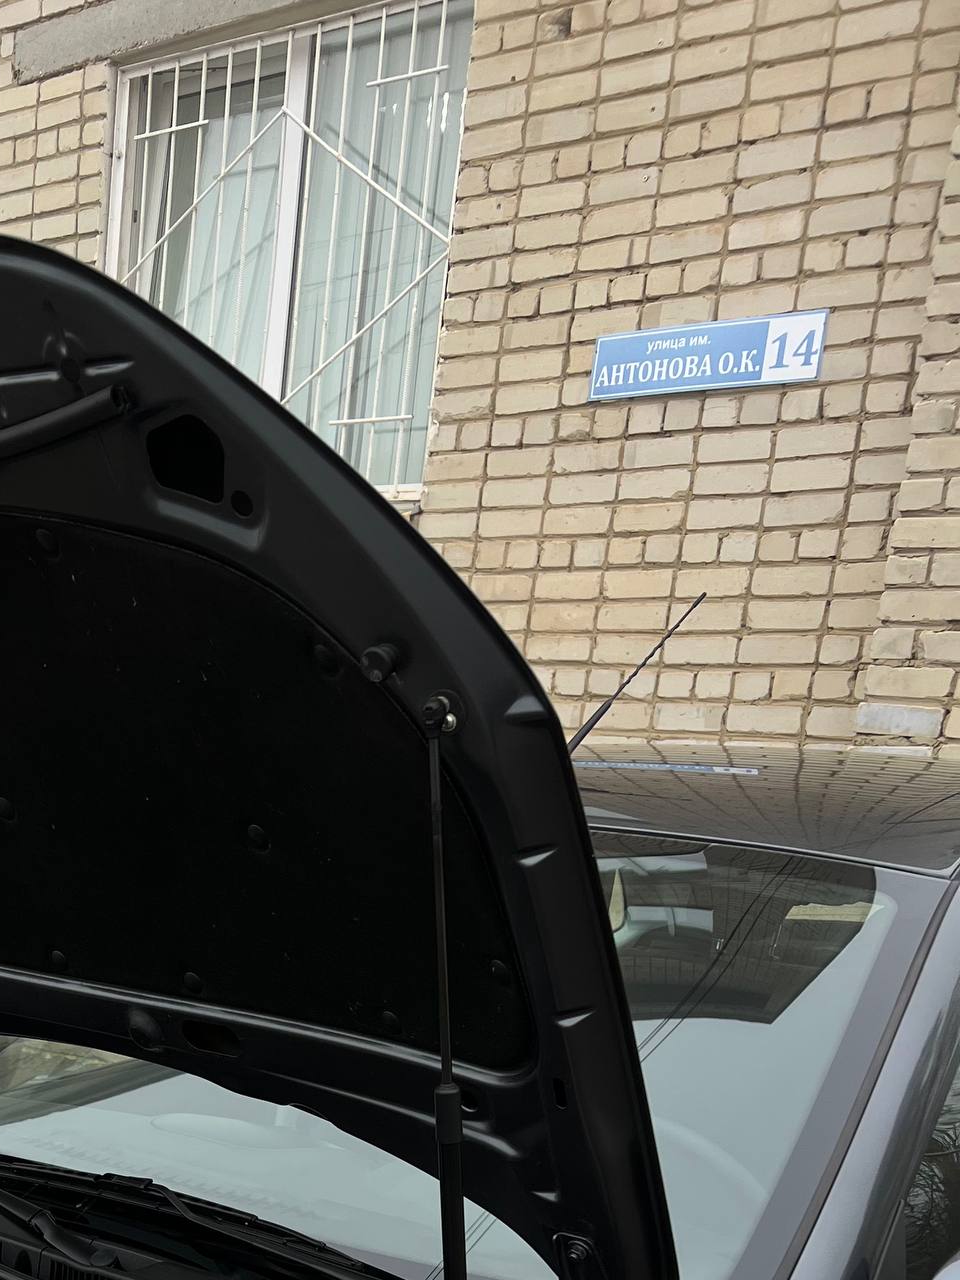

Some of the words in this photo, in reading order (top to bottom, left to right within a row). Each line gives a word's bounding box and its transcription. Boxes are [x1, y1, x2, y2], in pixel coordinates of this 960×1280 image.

[646, 336, 685, 355] улица
[689, 335, 711, 347] им.
[769, 329, 819, 369] 14
[595, 354, 712, 388] АНТОНОВА
[718, 349, 760, 375] О.К.
